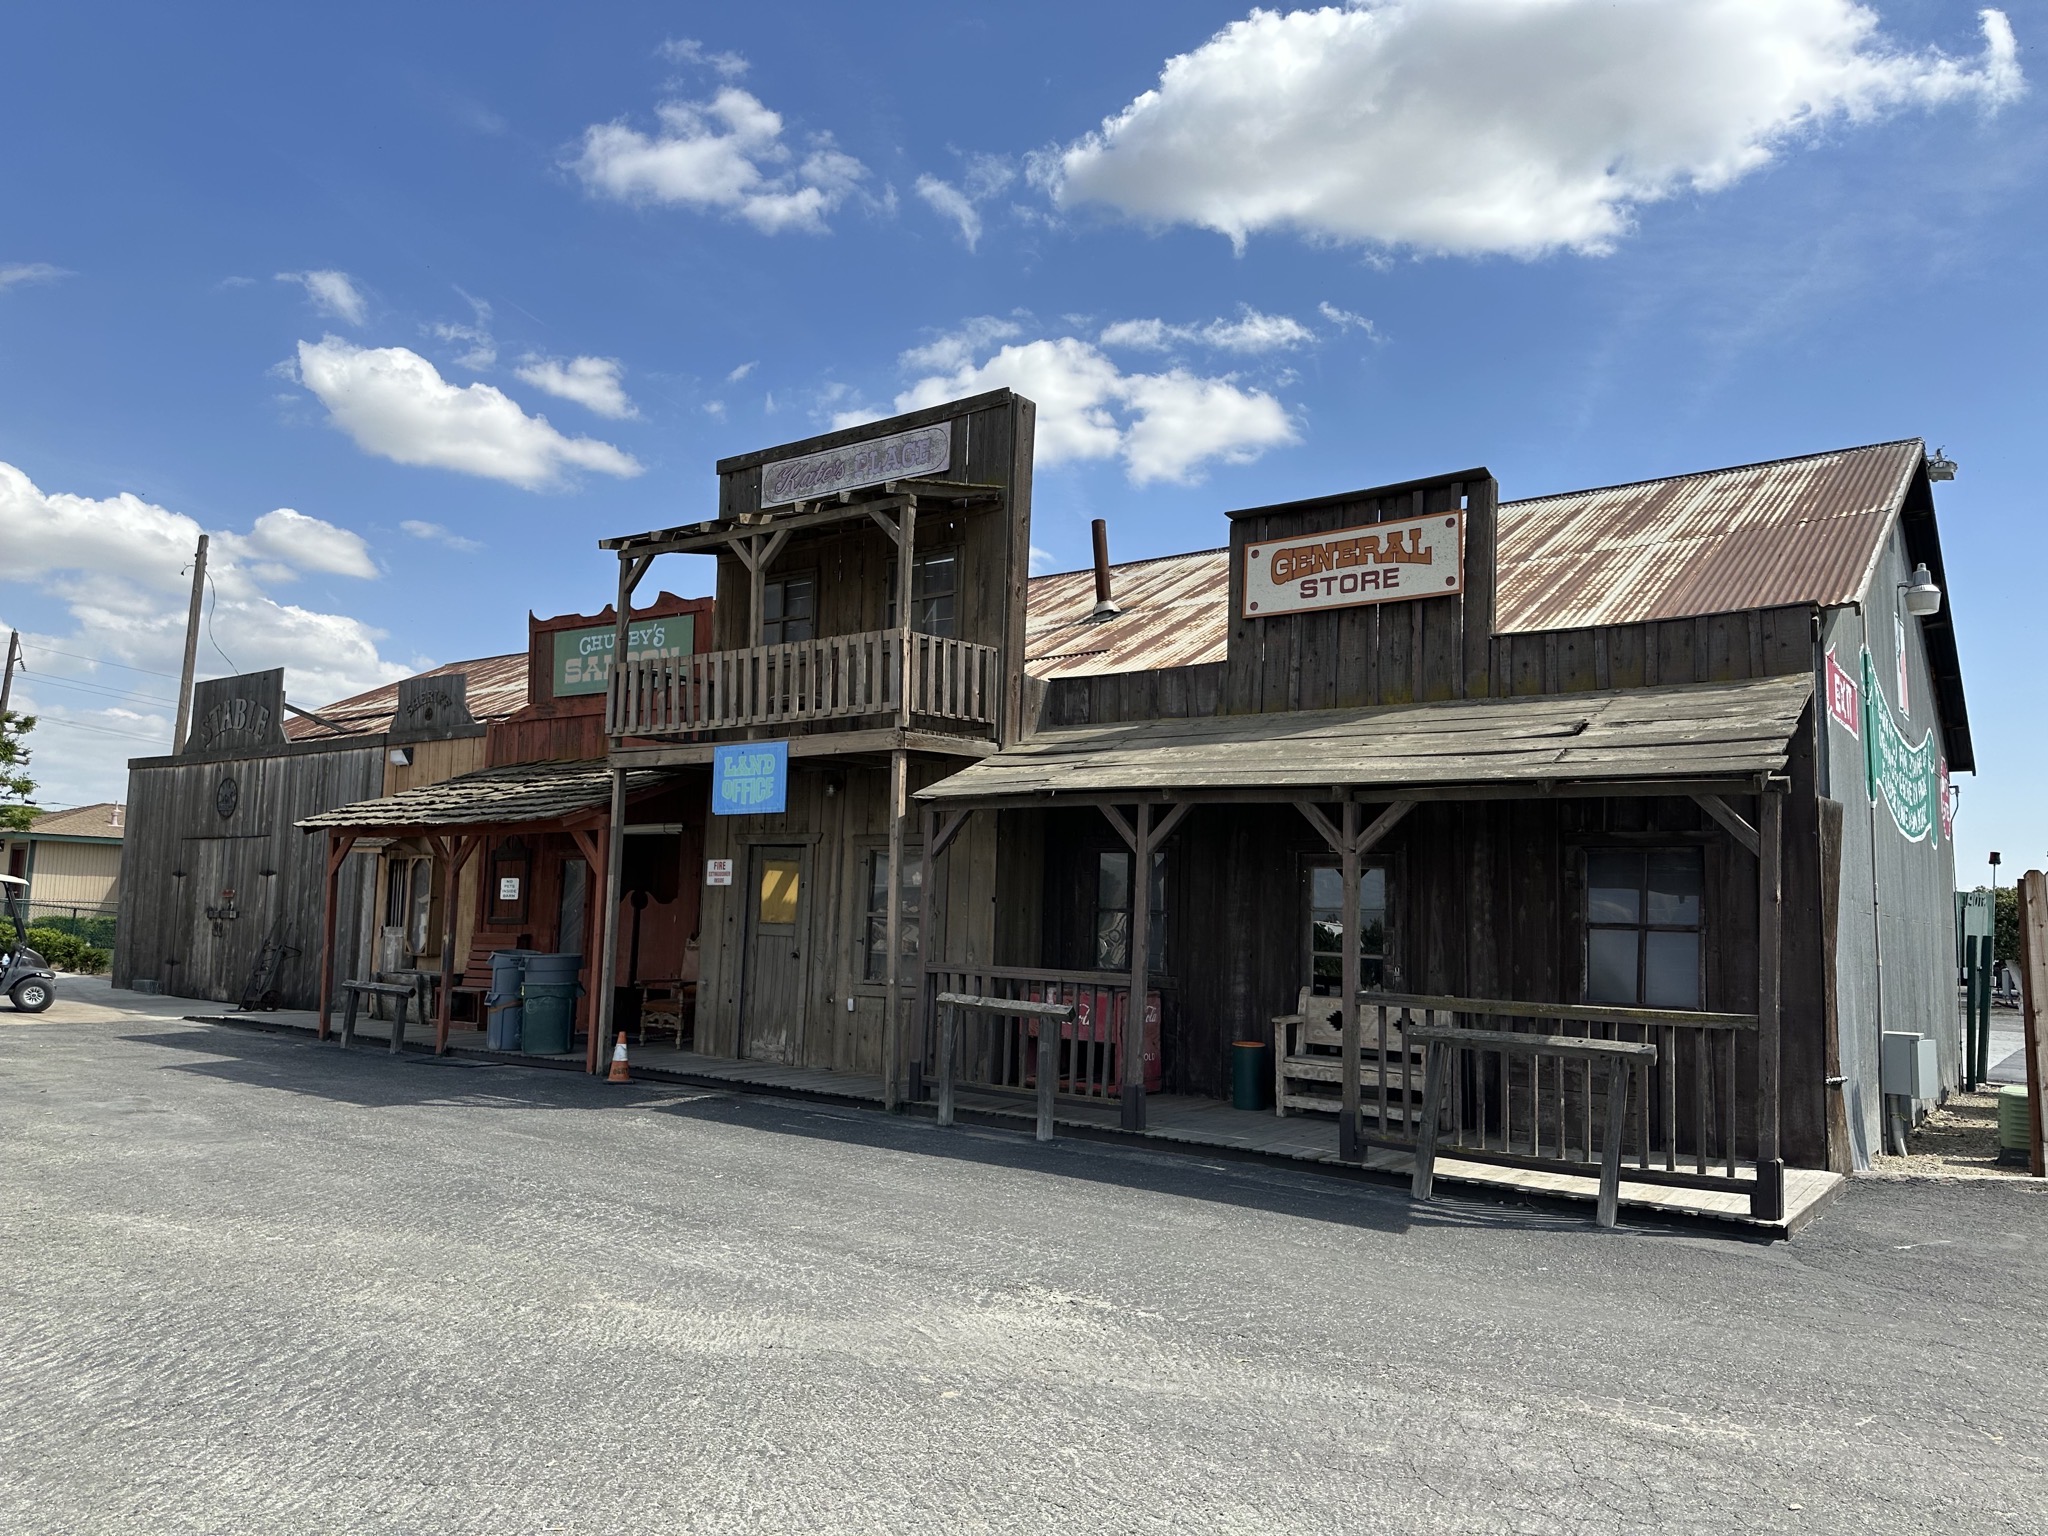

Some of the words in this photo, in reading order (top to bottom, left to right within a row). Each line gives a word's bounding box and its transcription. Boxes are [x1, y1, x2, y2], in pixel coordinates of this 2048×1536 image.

[775, 458, 846, 495] Kate's
[854, 438, 931, 480] PLACE
[1271, 528, 1433, 586] GENERAL
[1300, 567, 1400, 598] STORE
[581, 624, 664, 656] CHUBY'S
[407, 689, 452, 718] SHERIFF
[1834, 673, 1853, 724] EXIT
[201, 699, 270, 748] STABLE
[724, 754, 776, 777] LAND
[722, 777, 775, 805] OFFICE
[713, 861, 726, 870] FIRE
